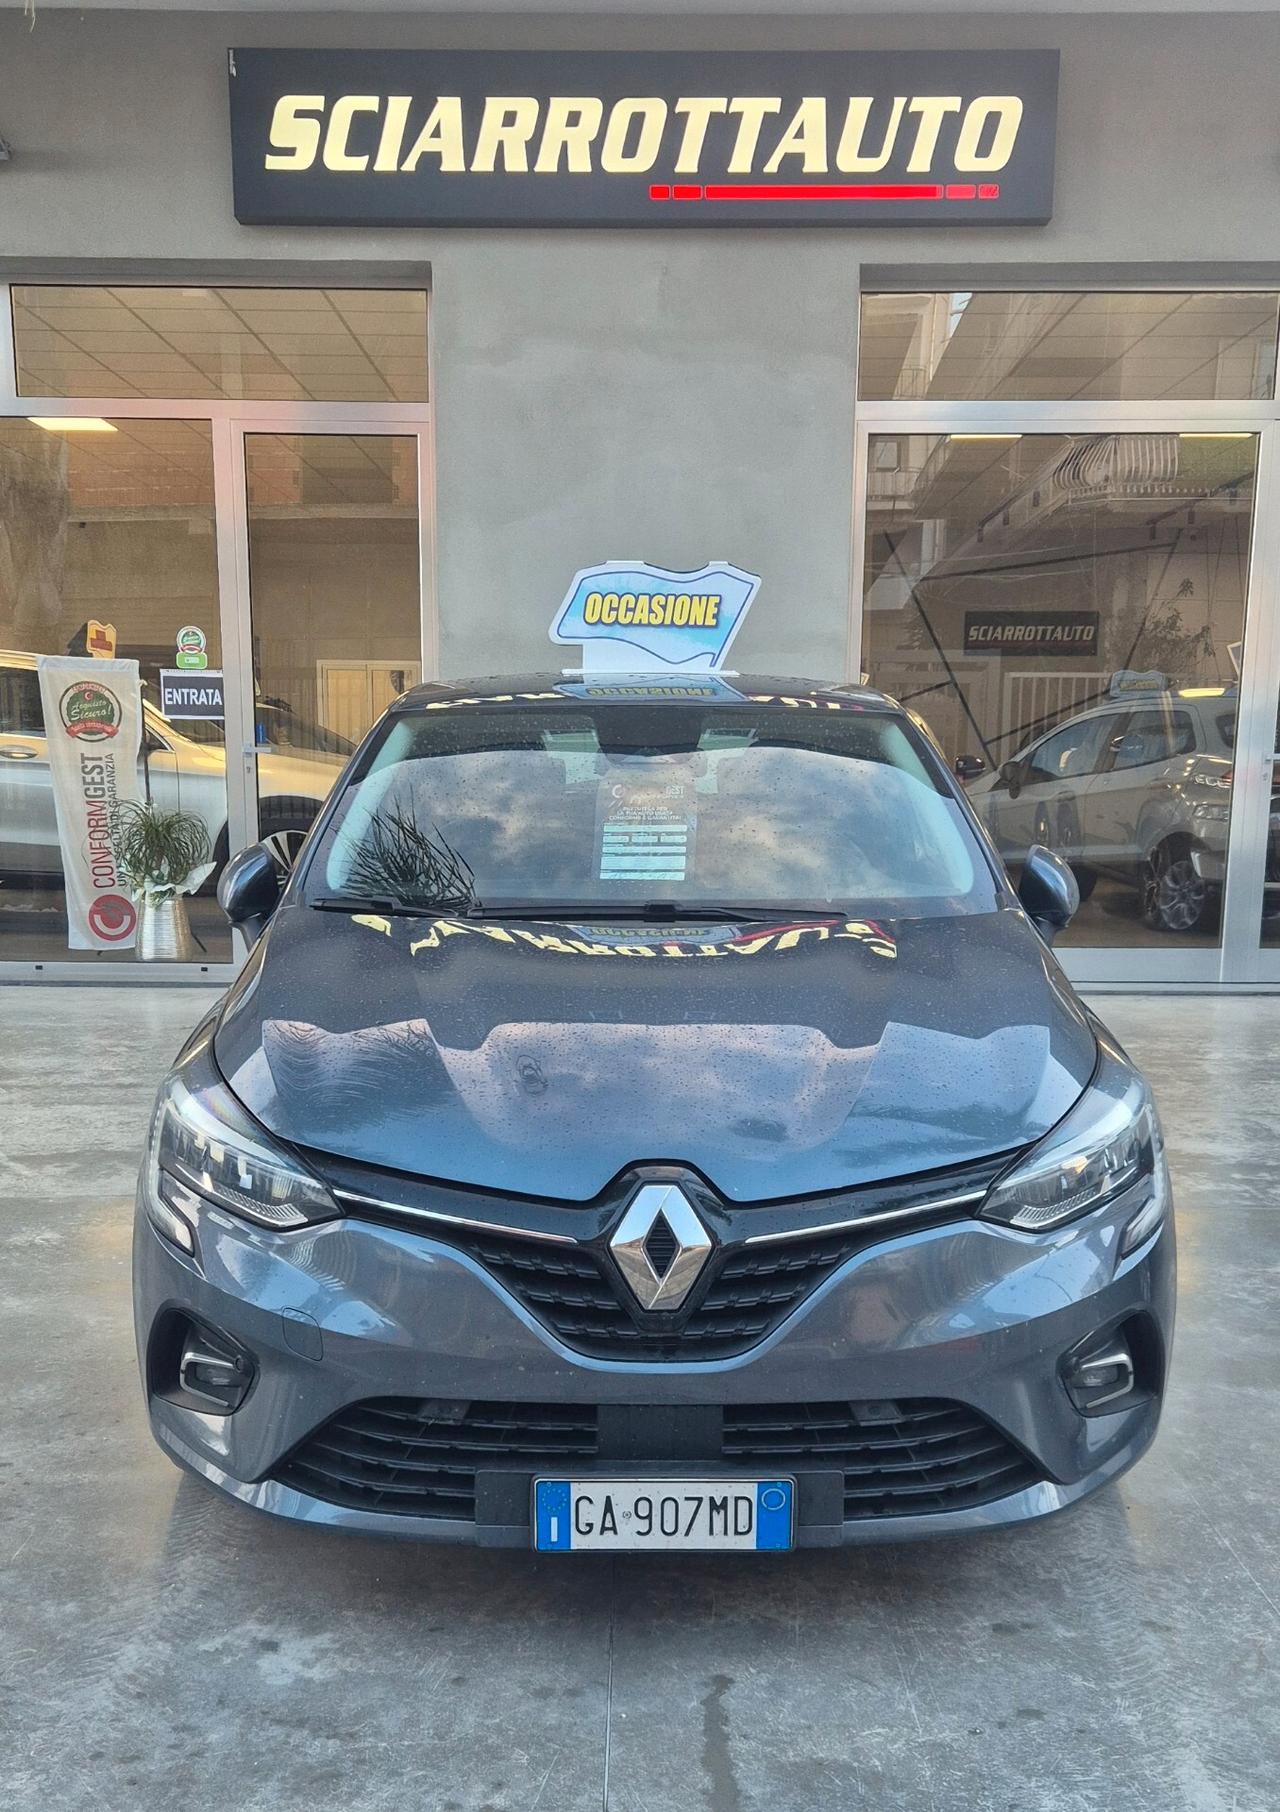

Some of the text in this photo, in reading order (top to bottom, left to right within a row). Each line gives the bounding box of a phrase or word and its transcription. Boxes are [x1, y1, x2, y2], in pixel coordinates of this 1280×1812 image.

[264, 95, 1024, 173] SCIARROTTAUTO
[583, 592, 721, 628] OCCASIONE
[968, 625, 1095, 641] SCIARROTTAUTO
[165, 688, 223, 705] ENTRATA
[81, 753, 116, 888] CONFORMGEST
[574, 1495, 754, 1537] GA 907MD
